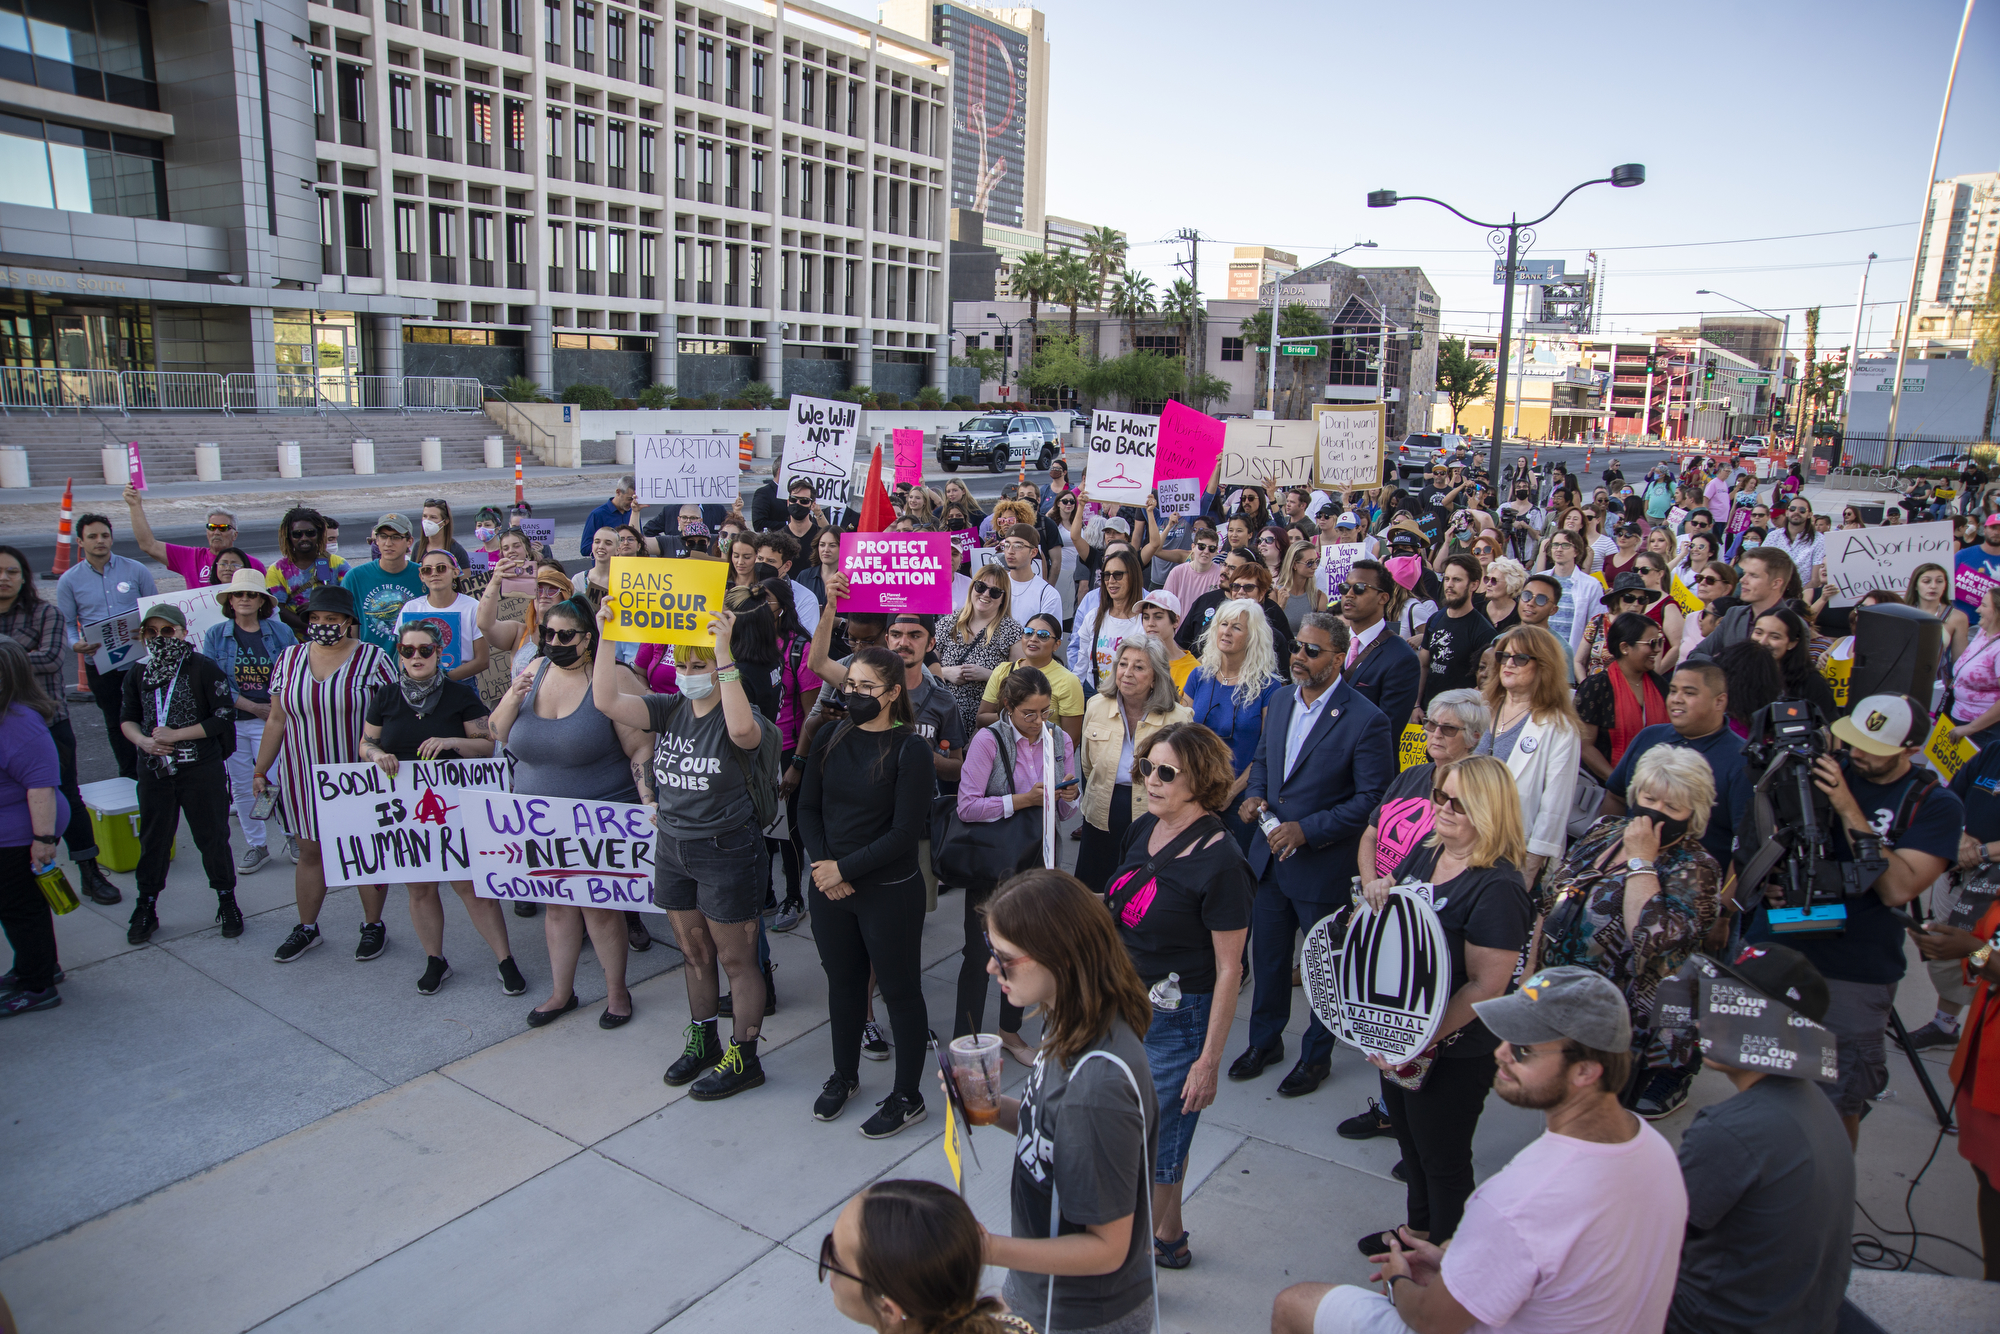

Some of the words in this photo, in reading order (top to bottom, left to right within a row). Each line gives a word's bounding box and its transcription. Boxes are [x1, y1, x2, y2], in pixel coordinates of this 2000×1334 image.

[967, 23, 1016, 138] D
[1017, 43, 1027, 103] VEGAS
[1015, 115, 1026, 149] LAS
[1496, 265, 1529, 273] NEDA
[26, 273, 71, 289] BLVD.
[76, 278, 126, 293] SOUTH
[1261, 286, 1305, 296] NEADA
[1261, 298, 1290, 307] STTE
[1287, 346, 1311, 354] Bridger
[797, 403, 824, 425] We
[828, 406, 856, 427] Will
[1325, 415, 1349, 430] Don't
[1353, 416, 1376, 429] want
[1096, 414, 1117, 433] WE
[1120, 419, 1157, 438] WON'T
[1342, 431, 1353, 439] an
[807, 427, 845, 446] NOT
[1255, 425, 1285, 448] I
[644, 438, 731, 459] ABORTION
[1091, 436, 1111, 453] GO
[1116, 437, 1156, 458] BACK
[1328, 450, 1344, 461] Get
[677, 461, 697, 474] is
[1225, 454, 1314, 481] DISSENT
[639, 475, 737, 499] HEALTHCARE
[815, 478, 850, 503] BACK
[1160, 484, 1179, 494] BANS
[1160, 494, 1173, 503] OFF
[1174, 493, 1195, 502] OUR
[1161, 503, 1190, 513] BODIES
[857, 540, 928, 554] PROTECT
[1325, 546, 1332, 557] If
[1841, 534, 1949, 563] Abortion
[845, 556, 888, 571] SAFE,
[891, 556, 942, 570] LEGAL
[1877, 558, 1892, 567] is
[620, 572, 673, 592] BANS
[850, 571, 936, 585] ABORTION
[1328, 574, 1347, 584] DON
[1833, 573, 1911, 599] Health
[1955, 574, 1976, 589] SAFE,
[1976, 582, 1990, 593] LEG
[363, 586, 381, 610] PROTECT
[1955, 581, 1986, 599] ABORTI
[619, 591, 657, 609] OFF
[659, 592, 707, 612] OUR
[620, 610, 697, 631] BODIES
[101, 621, 117, 651] NEVADA
[116, 618, 131, 645] VICTORY
[235, 657, 257, 665] OOD
[260, 657, 272, 665] DA
[243, 666, 270, 674] READ
[239, 683, 263, 691] OKS
[1828, 677, 1851, 687] OU
[660, 731, 696, 754] ANS
[1401, 731, 1428, 743] ODIES
[1936, 734, 1952, 753] OFF
[1939, 725, 1960, 752] BAS
[1400, 741, 1413, 753] OU
[680, 757, 721, 774] OUR
[413, 760, 505, 791] AUTONOMY
[653, 768, 710, 791] ODIES
[375, 798, 407, 827] IS
[485, 798, 556, 837] WE
[573, 803, 653, 840] ARE
[336, 829, 430, 881] HUMAN
[525, 838, 656, 869] NEVER
[486, 871, 574, 902] GOING
[1965, 884, 1998, 894] BODIES
[1953, 905, 1969, 915] DIES
[1343, 893, 1438, 1016] NOW
[1305, 949, 1314, 968] FOR
[1310, 971, 1321, 1009] WOMEN
[1310, 937, 1330, 1021] ORGANIZATION
[1317, 928, 1340, 1031] NATIONAL
[1711, 983, 1746, 997] BANS
[1709, 993, 1736, 1005] OFF
[1736, 996, 1768, 1009] OUR
[1709, 1003, 1762, 1018] BODIES
[1347, 1005, 1425, 1031] NATIONAL
[1351, 1021, 1416, 1044] ORGANIZATION
[1742, 1033, 1779, 1048] BANS
[1360, 1035, 1376, 1047] FOR
[1376, 1037, 1406, 1053] WOMEN
[1740, 1043, 1768, 1055] OFF
[1767, 1047, 1798, 1061] OUR
[1739, 1053, 1793, 1070] BODIES
